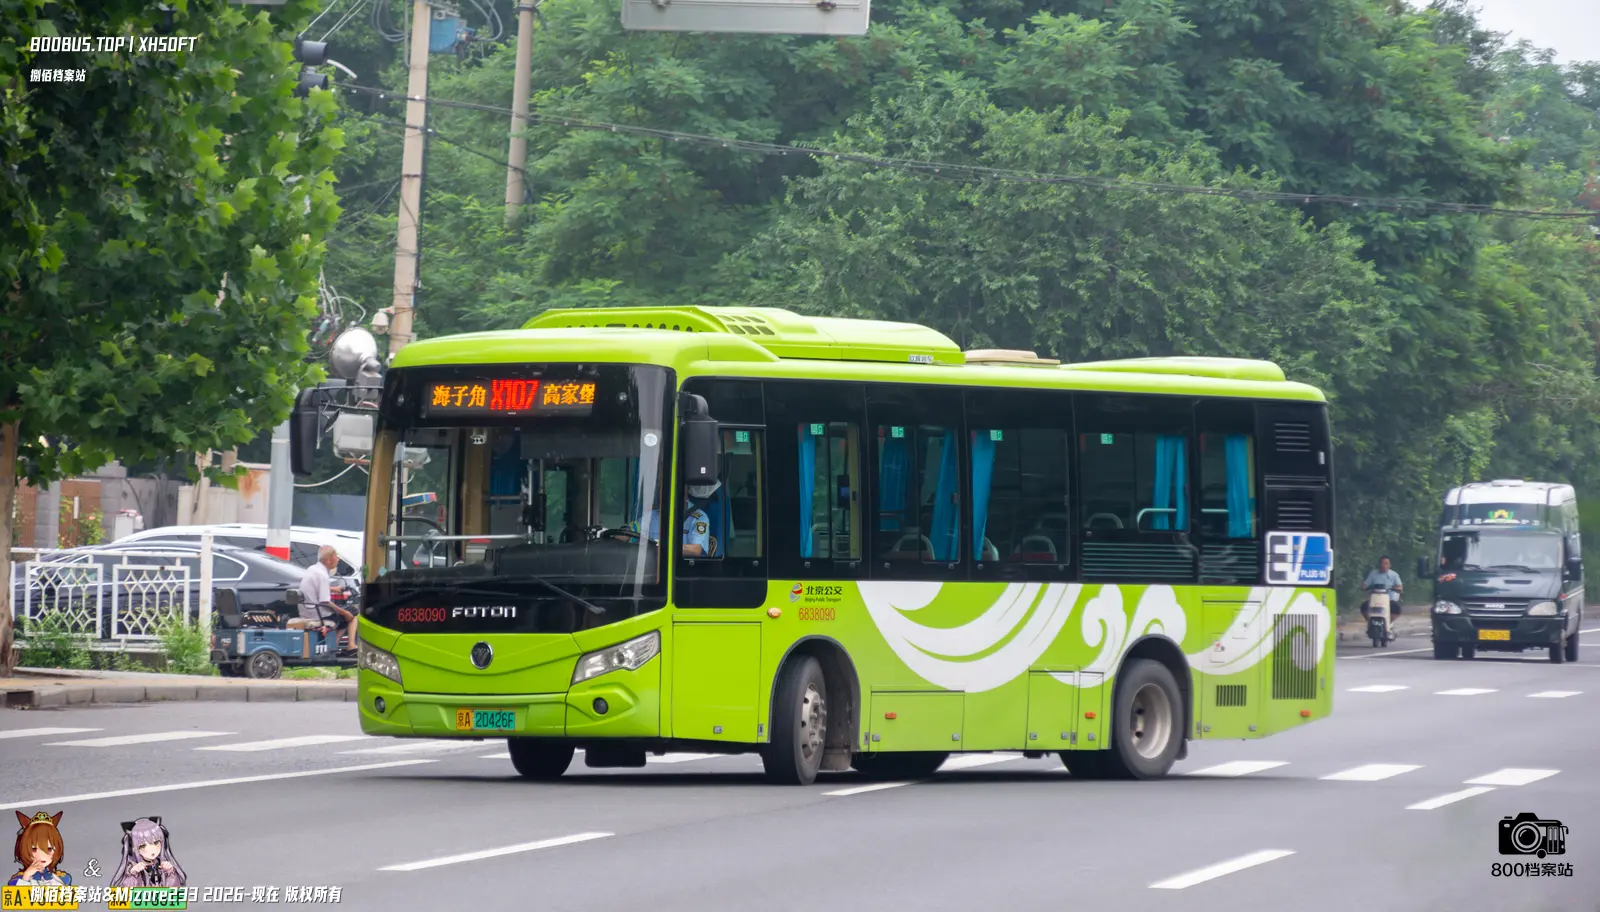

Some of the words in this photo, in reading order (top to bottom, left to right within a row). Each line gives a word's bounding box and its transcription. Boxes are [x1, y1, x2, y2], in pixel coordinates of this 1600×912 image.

[432, 384, 487, 407] 海子角
[490, 379, 540, 411] X107
[543, 383, 596, 405] 高家堡
[805, 586, 842, 595] 北京公交
[398, 607, 447, 622] 6838090
[452, 606, 517, 618] FOTON
[798, 607, 835, 620] 6838090
[475, 711, 514, 728] 20426F
